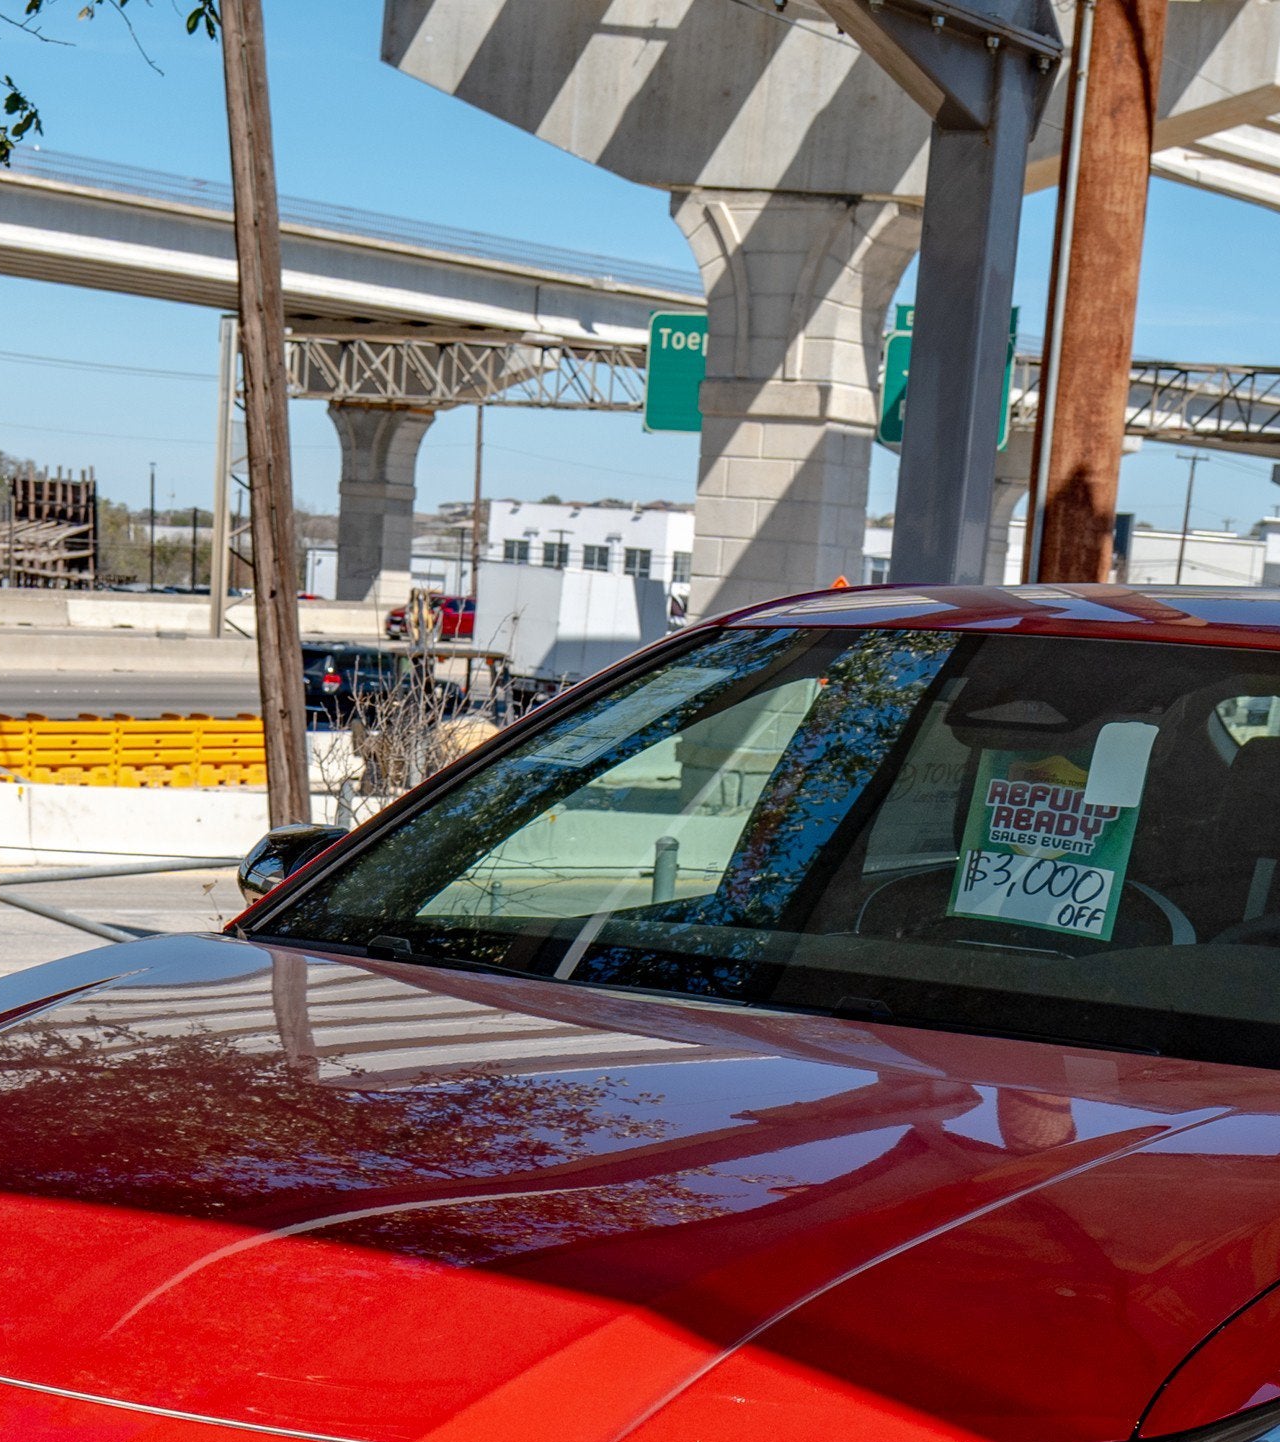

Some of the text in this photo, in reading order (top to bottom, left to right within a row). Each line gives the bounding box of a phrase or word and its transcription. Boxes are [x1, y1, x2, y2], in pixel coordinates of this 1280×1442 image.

[659, 328, 707, 356] Toe
[992, 806, 1103, 840] READY
[991, 831, 1093, 854] SALES EVENT
[964, 850, 1105, 904] $3,000
[1057, 904, 1106, 928] OFF
